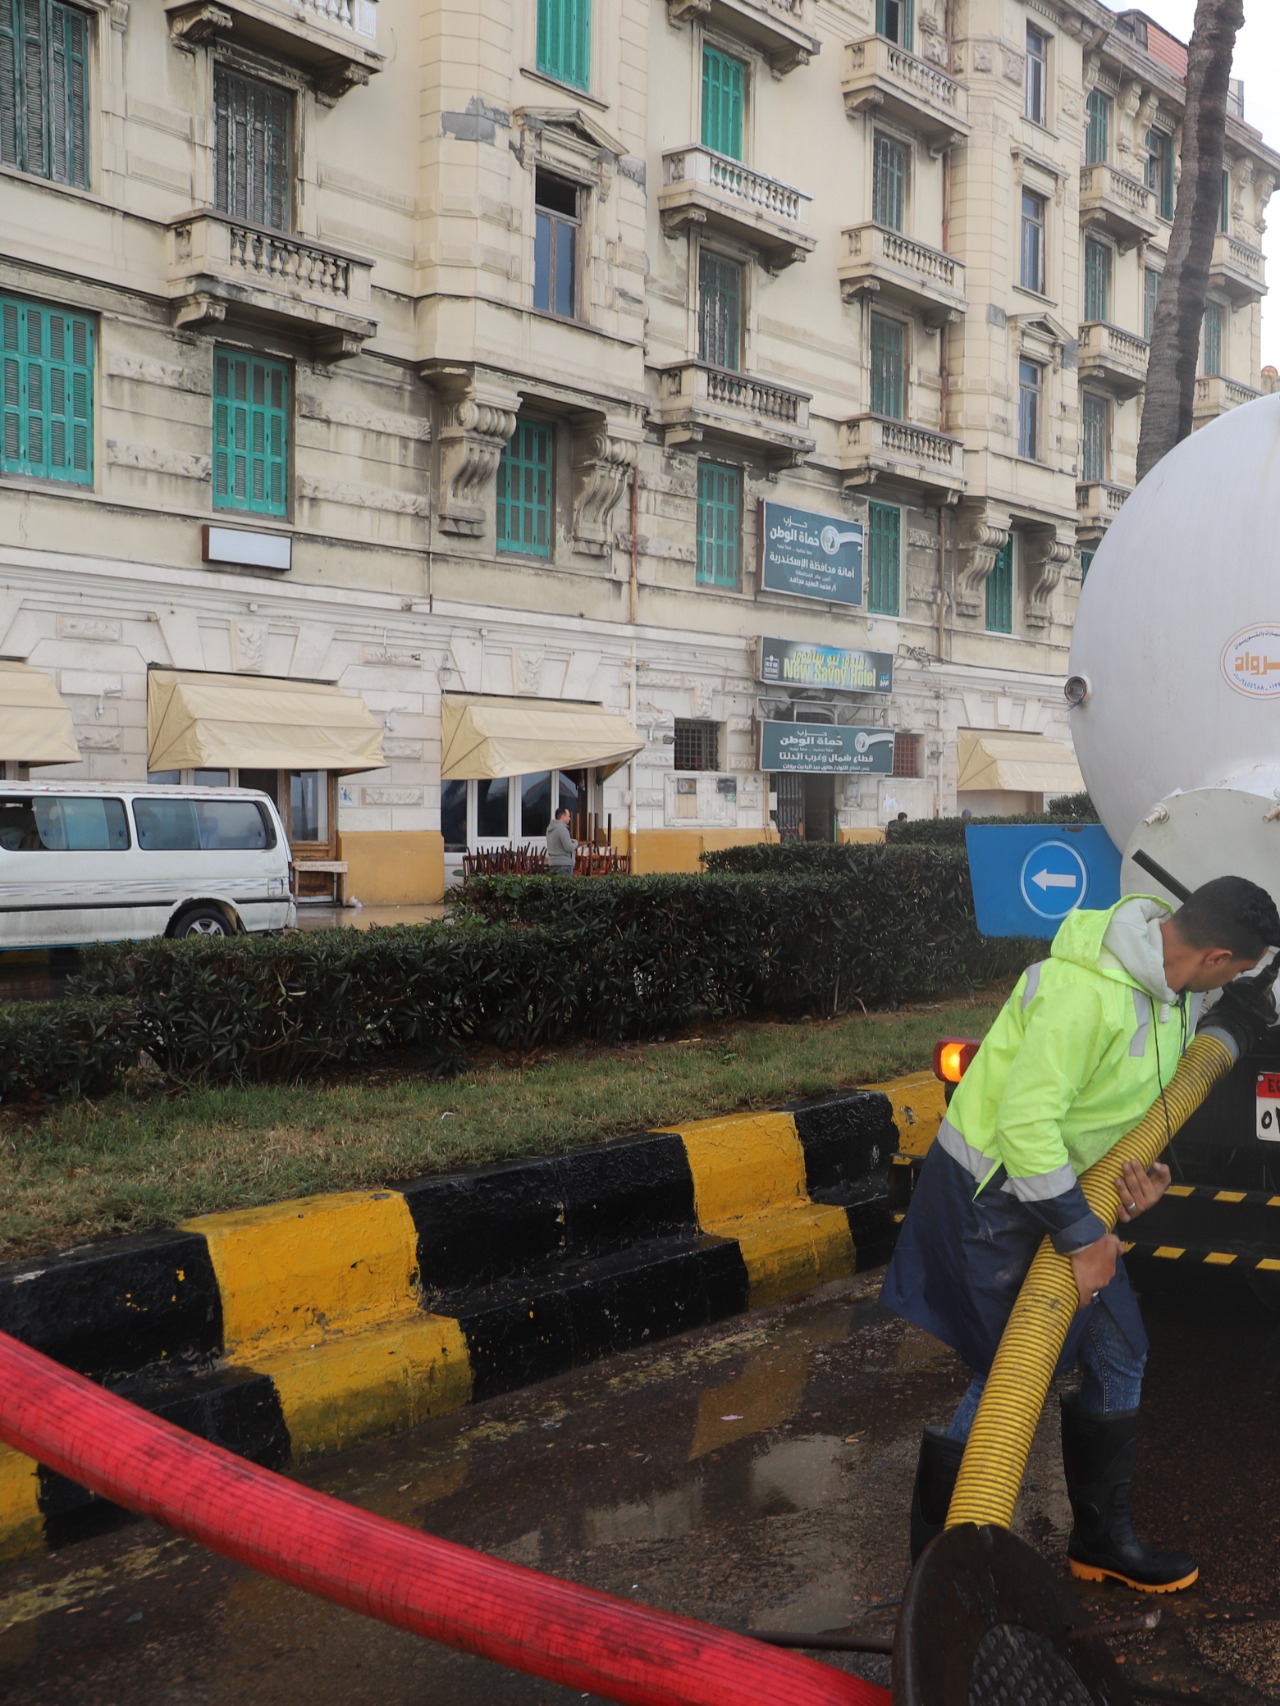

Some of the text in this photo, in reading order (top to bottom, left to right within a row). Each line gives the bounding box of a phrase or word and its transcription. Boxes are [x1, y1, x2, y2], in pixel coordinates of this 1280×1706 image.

[783, 515, 808, 529] حزب
[769, 525, 797, 543] الوطن
[769, 551, 855, 579] أمانة محافظة الإسكندرية
[783, 657, 810, 680] New
[815, 663, 847, 688] Savoy
[850, 666, 877, 688] Hotel
[797, 729, 828, 738] حزب
[779, 735, 815, 747] الوطن
[804, 753, 827, 763] وغرب
[828, 753, 852, 763] شمال
